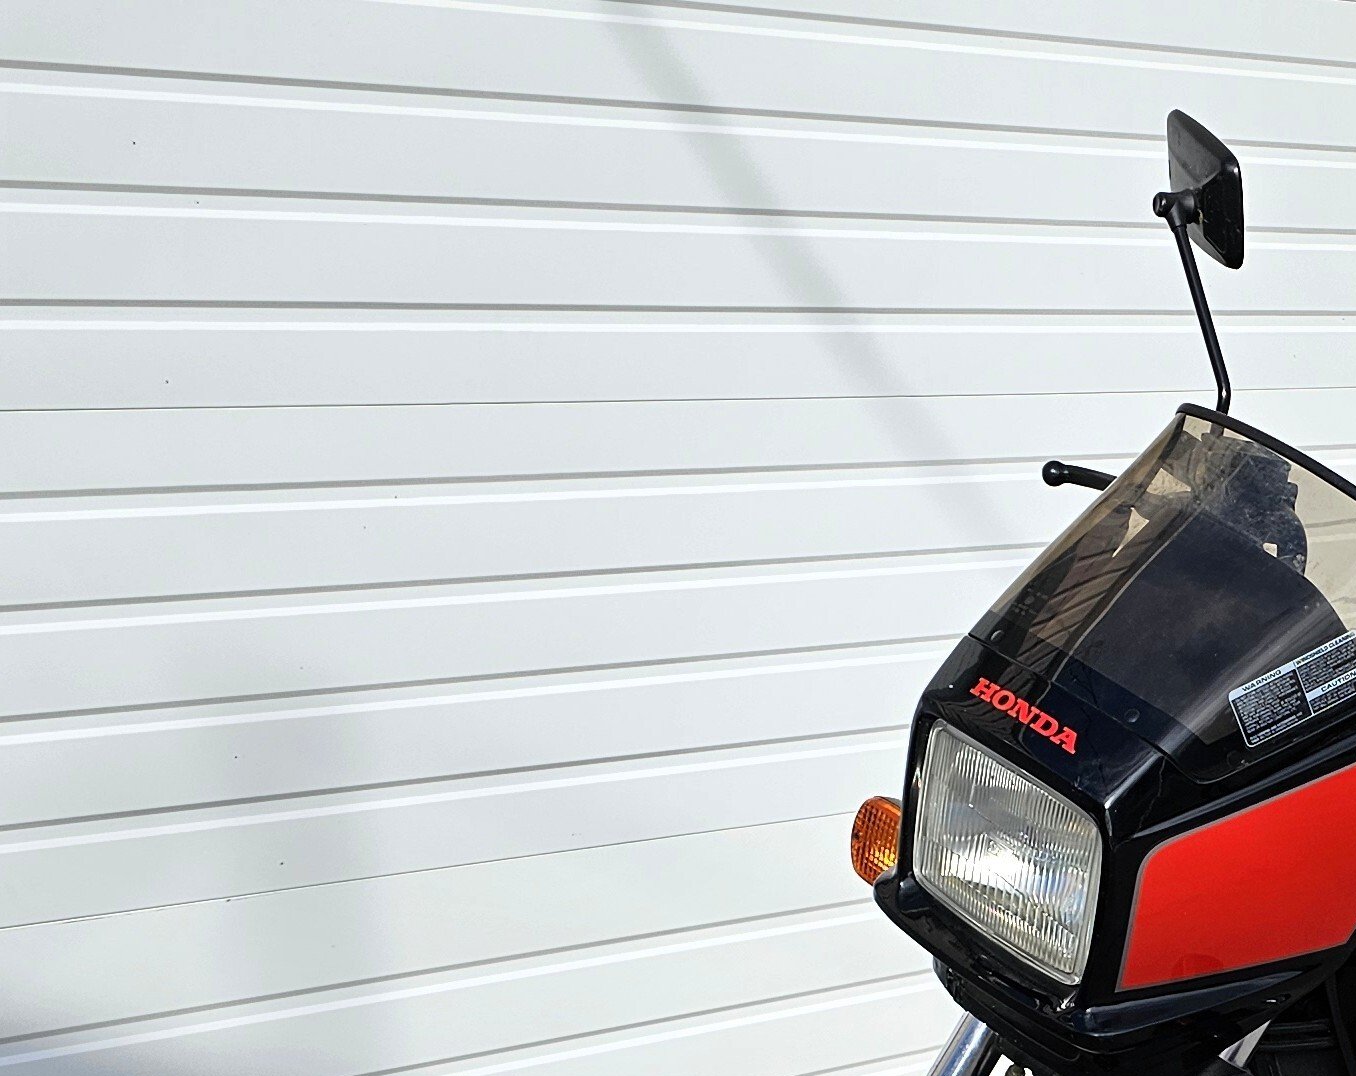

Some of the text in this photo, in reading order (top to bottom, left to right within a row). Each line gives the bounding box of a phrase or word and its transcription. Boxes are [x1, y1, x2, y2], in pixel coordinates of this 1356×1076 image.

[1242, 669, 1282, 692] WARNING
[1321, 670, 1356, 692] CAUTION
[969, 677, 1078, 755] HONDA
